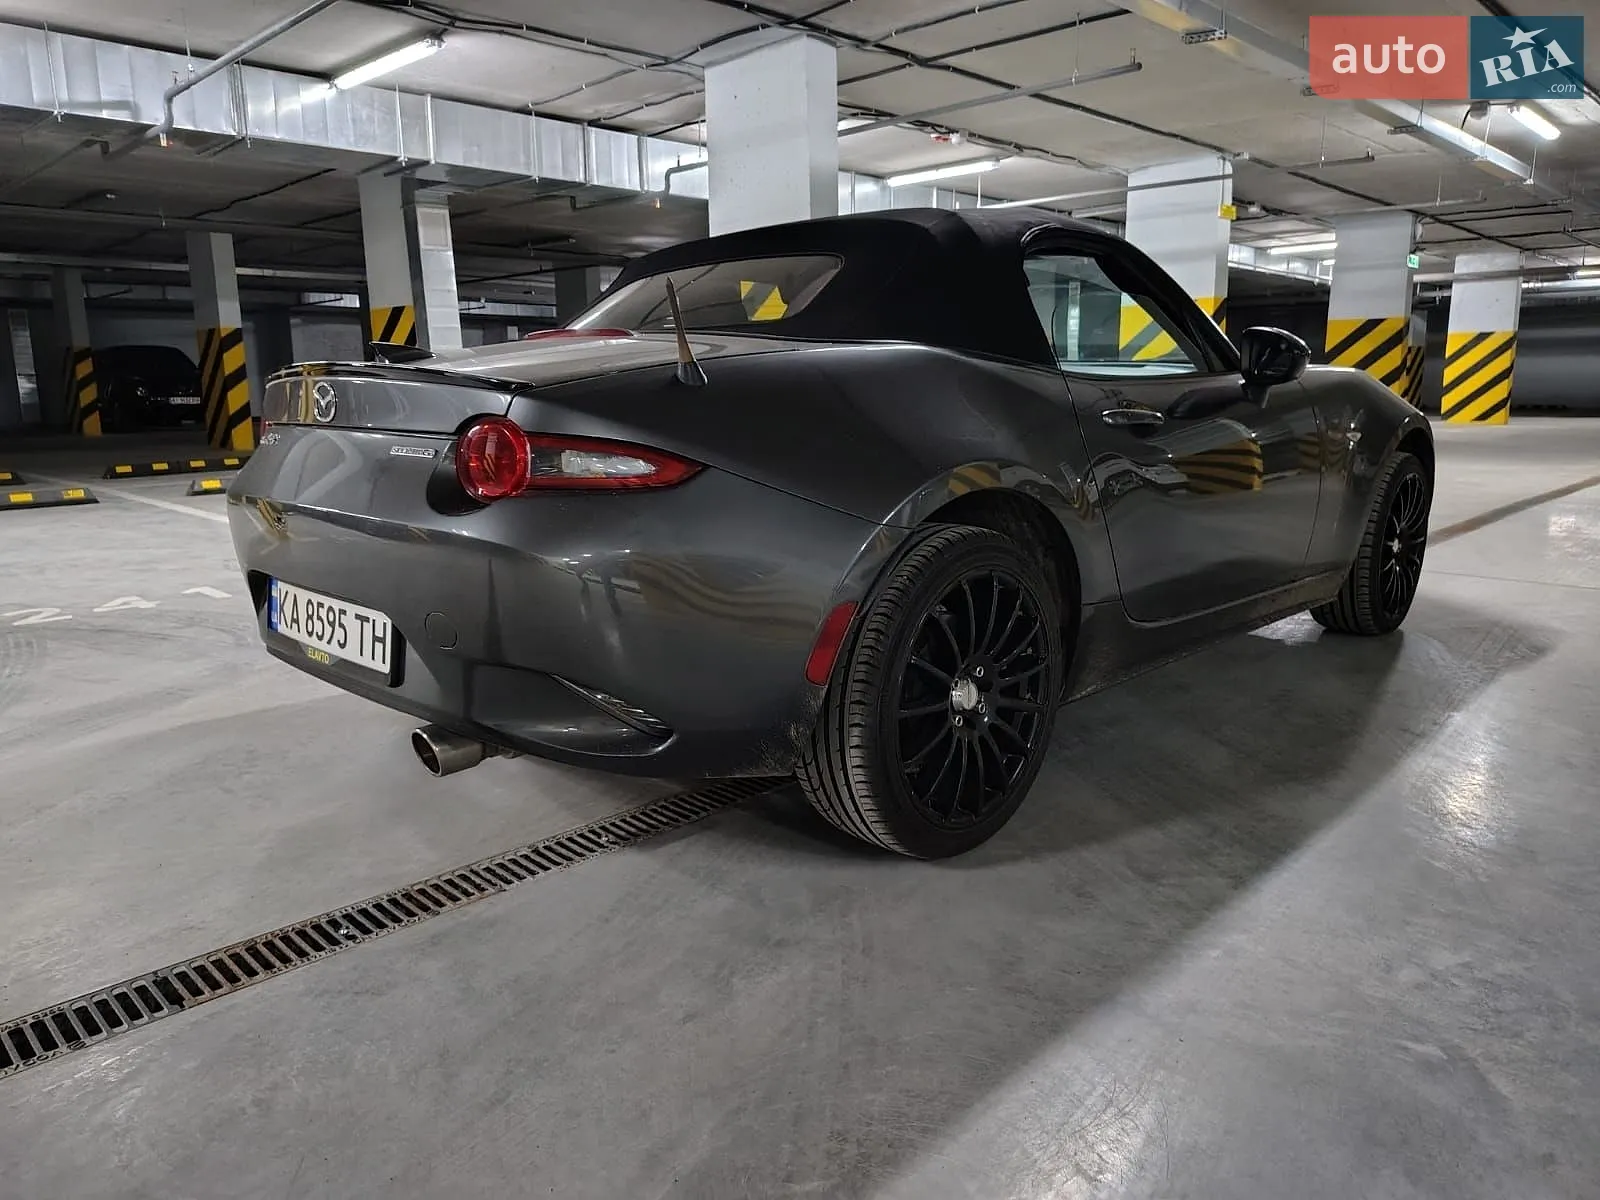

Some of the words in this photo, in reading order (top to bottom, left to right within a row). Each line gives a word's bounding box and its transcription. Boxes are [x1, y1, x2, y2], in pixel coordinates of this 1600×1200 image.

[279, 588, 301, 634] KA
[305, 598, 348, 650] 8595
[354, 612, 388, 665] TH
